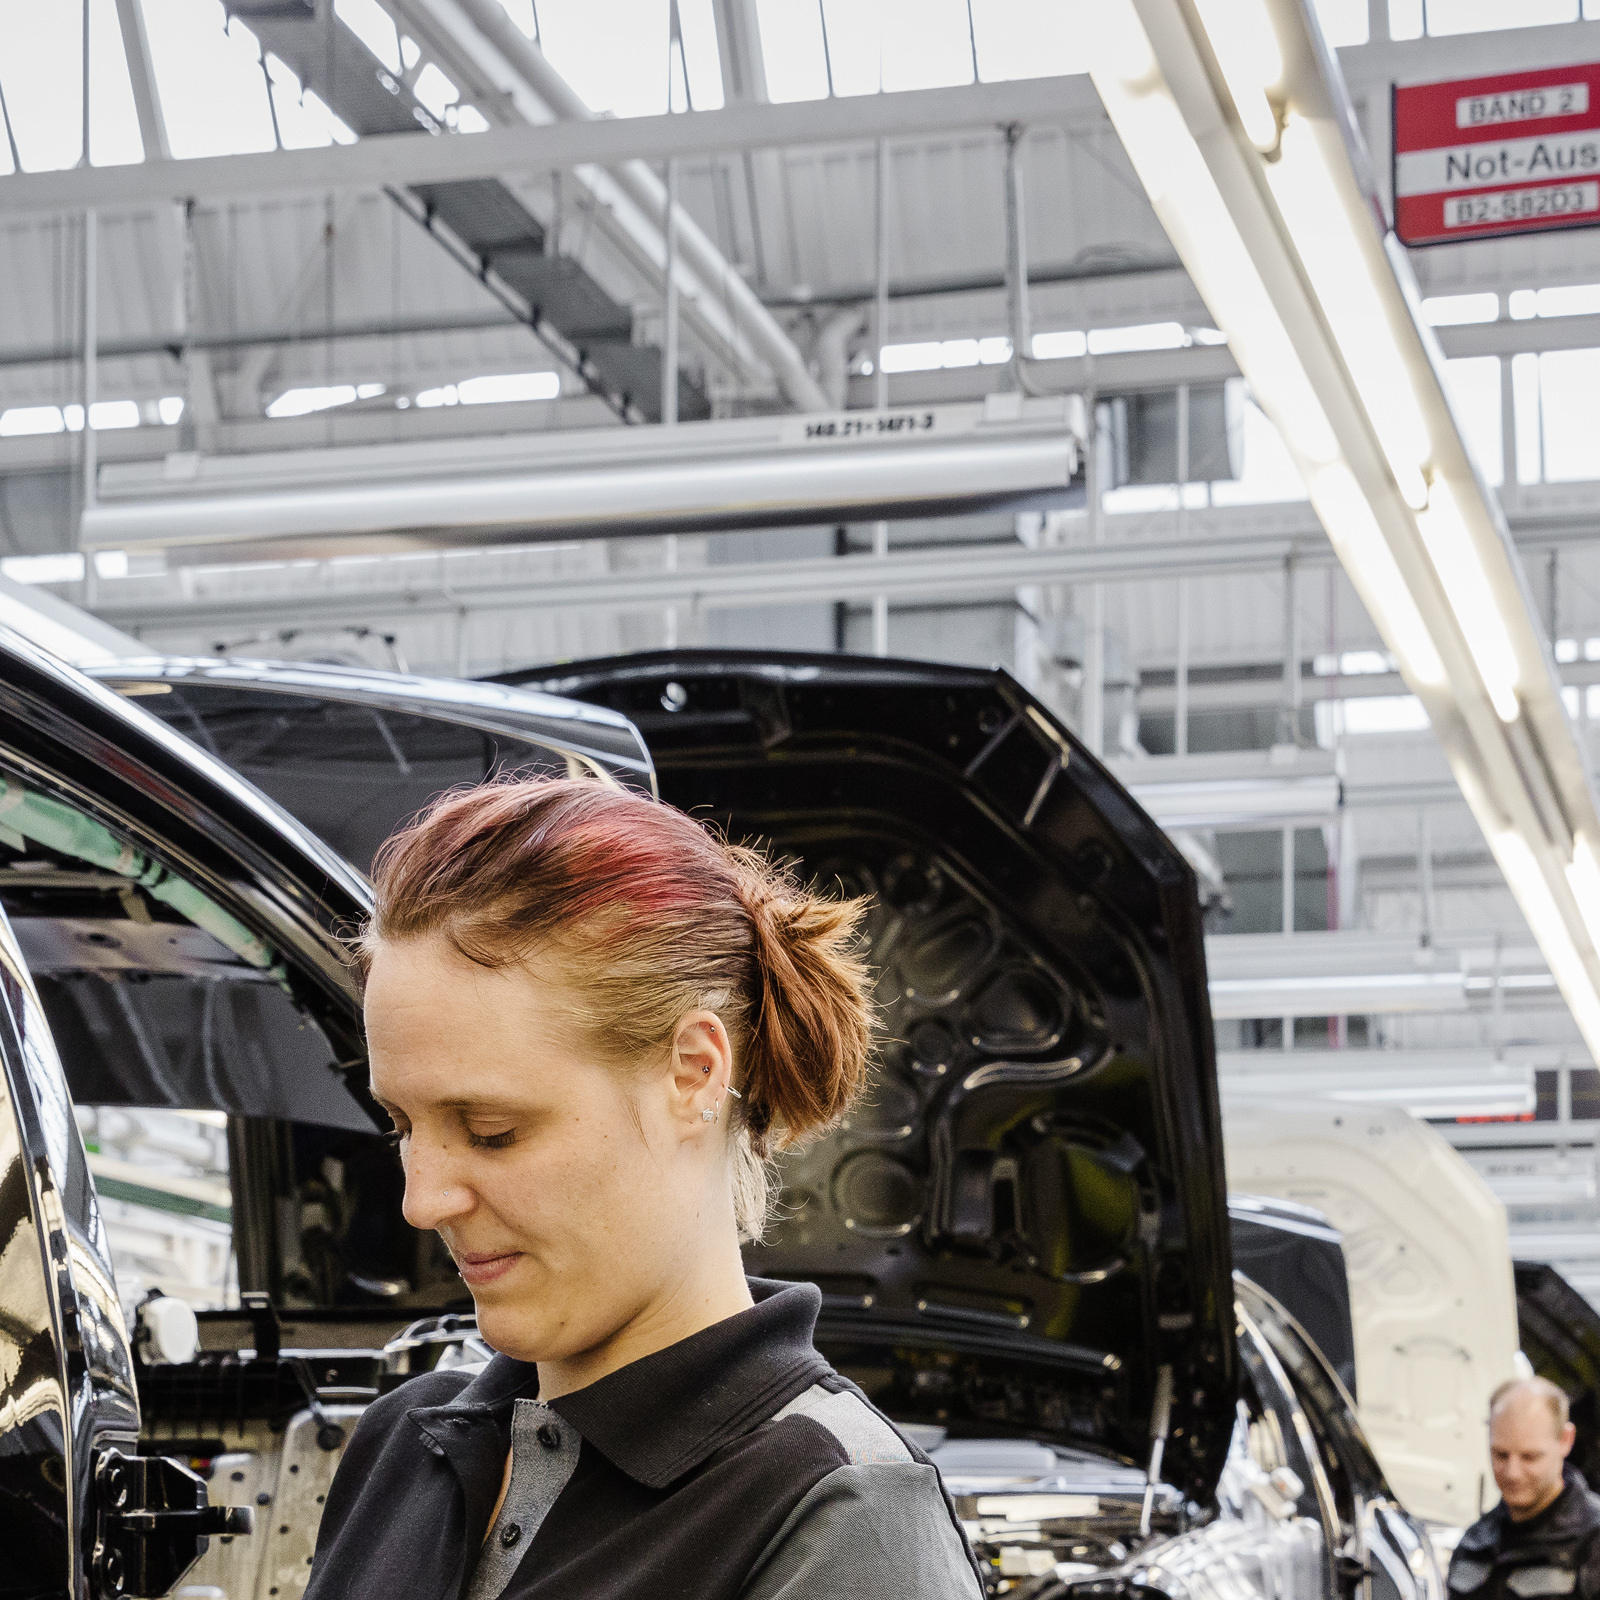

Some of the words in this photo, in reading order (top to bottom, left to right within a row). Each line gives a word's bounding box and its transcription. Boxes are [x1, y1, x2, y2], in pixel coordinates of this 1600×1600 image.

[1469, 92, 1546, 124] BAND
[1559, 88, 1574, 113] 2
[1447, 142, 1598, 183] Not-Aus
